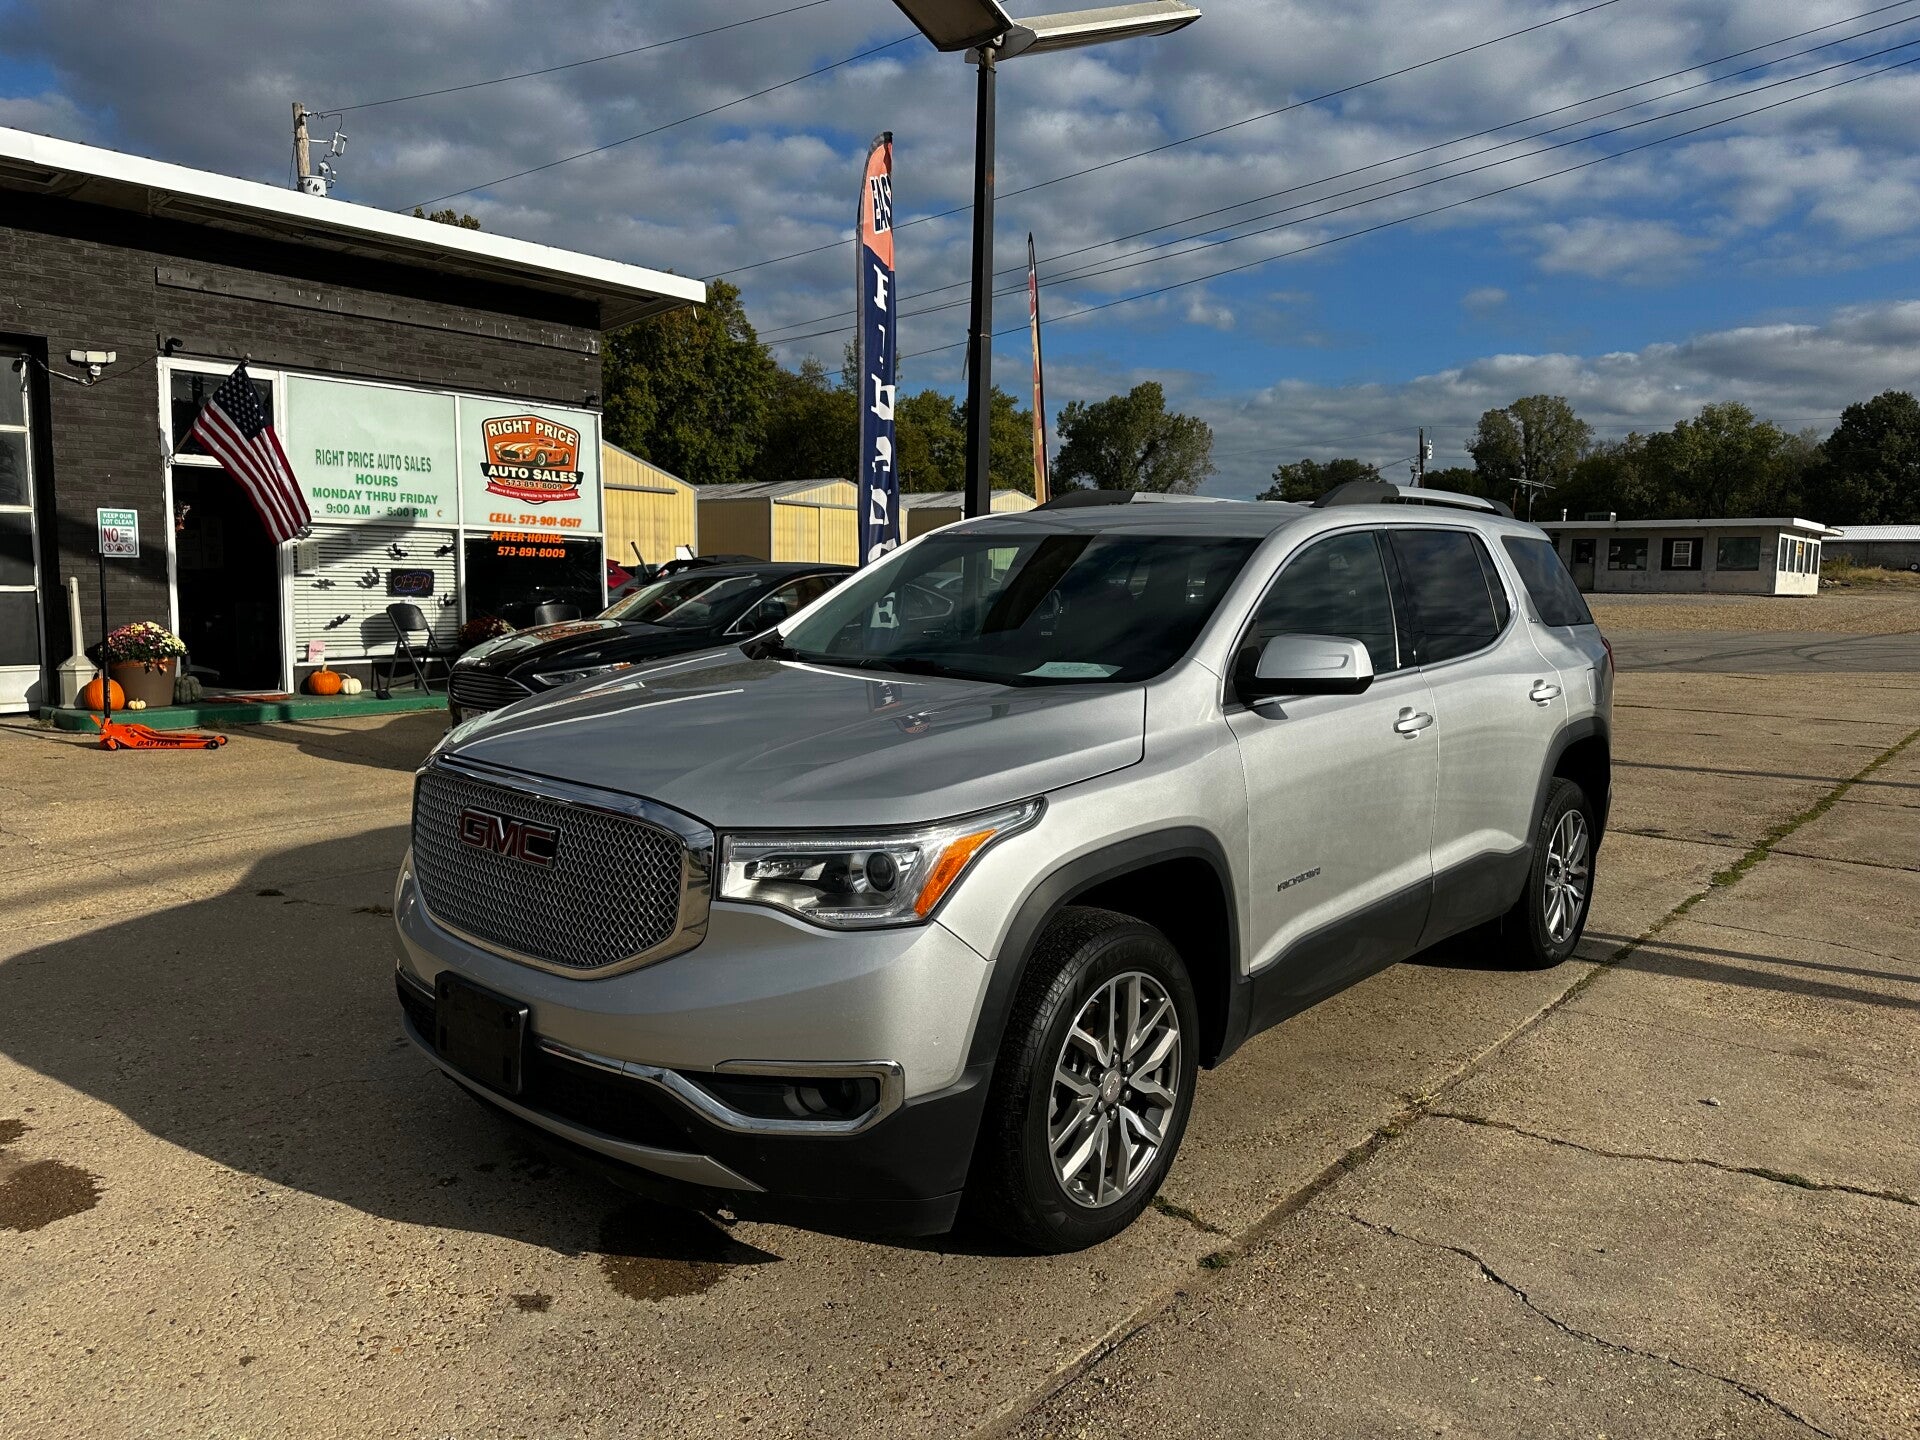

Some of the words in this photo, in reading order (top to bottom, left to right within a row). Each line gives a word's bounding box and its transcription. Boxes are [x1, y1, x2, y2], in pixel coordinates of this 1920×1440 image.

[869, 173, 892, 234] EAS
[488, 420, 531, 437] RIGHT
[535, 422, 576, 447] PRICE
[315, 449, 344, 466] RIGHT
[347, 451, 375, 469] PRICE
[377, 454, 402, 471] AUTO
[404, 455, 432, 473] SALES
[356, 474, 399, 487] HOURS
[488, 465, 529, 478] AUTO
[532, 469, 577, 483] SALES
[505, 480, 563, 490] 573-891-8009
[312, 487, 363, 501] MONDAY
[365, 490, 397, 503] THRU
[400, 492, 438, 505] FRIDAY
[326, 503, 351, 514] 9:00
[353, 504, 371, 515] AM
[387, 506, 410, 517] 5:00
[412, 507, 429, 518] PM
[489, 512, 517, 524] CELL:
[518, 514, 583, 528] 573-901-0517
[103, 527, 119, 543] NO
[497, 546, 567, 558] 573-891-8009
[394, 575, 431, 588] OPEN
[460, 807, 556, 868] GMC
